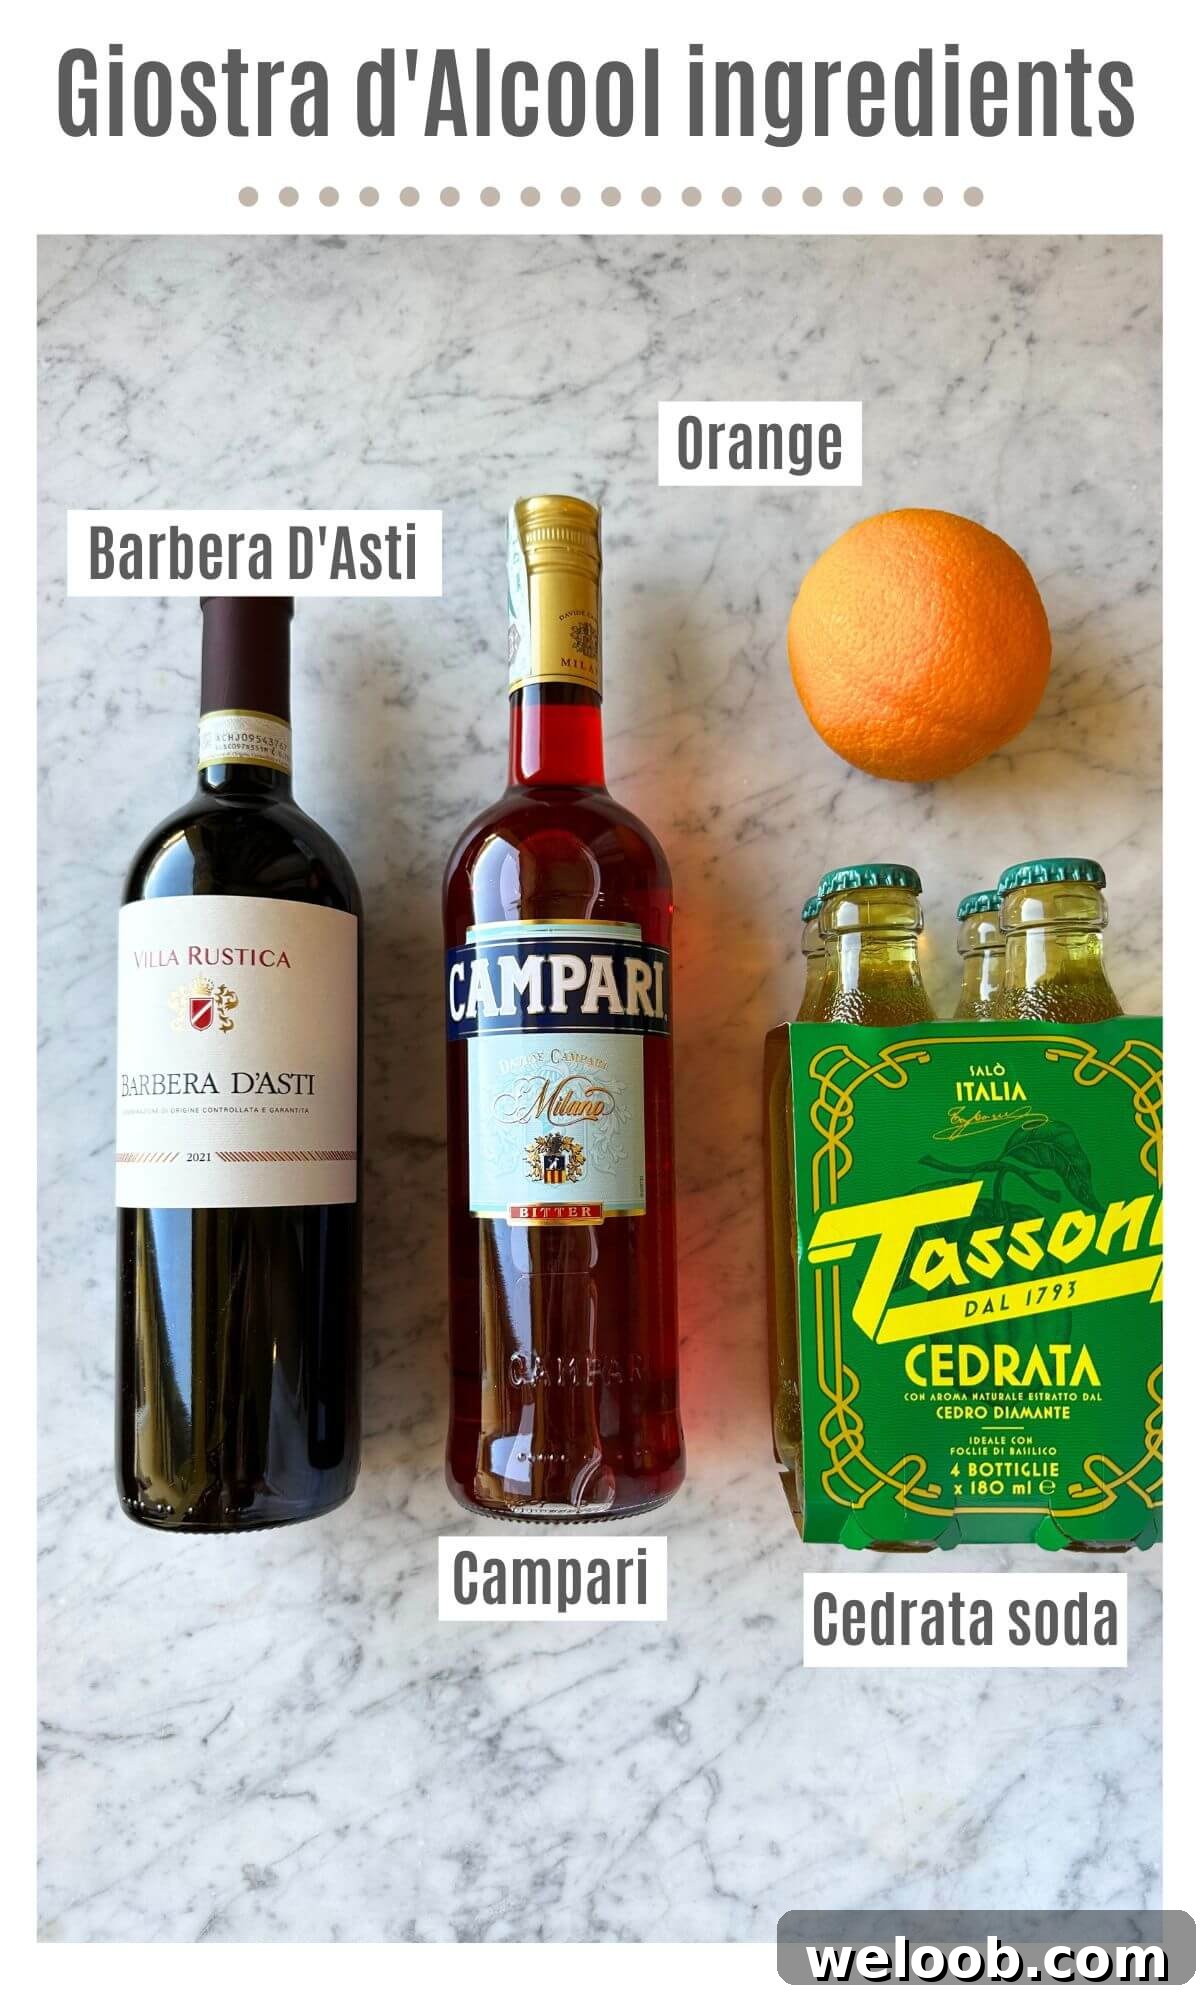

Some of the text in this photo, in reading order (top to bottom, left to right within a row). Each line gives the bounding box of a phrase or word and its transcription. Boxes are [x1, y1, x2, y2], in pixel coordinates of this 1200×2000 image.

[561, 656, 597, 673] MILA
[134, 946, 291, 969] VILLA RUSTICA
[449, 954, 665, 1022] CAMPARI
[969, 1062, 1006, 1077] SALÒ
[121, 1071, 315, 1097] BARBERA D'ASTI
[956, 1081, 1027, 1101] ITALIA
[496, 1075, 615, 1126] Milano
[202, 1106, 259, 1114] CONTROLLATA
[186, 1152, 212, 1162] 2021
[520, 1206, 591, 1218] BITTER
[965, 1281, 1077, 1318] DAL 1793
[905, 1343, 1101, 1387] CEDRATA
[904, 1392, 1102, 1402] CON AROMA NATURALE ESTRATTO DAL
[936, 1406, 1071, 1420] CEDRO DIAMANTE
[969, 1436, 1033, 1445] IDEALE CON
[950, 1447, 1057, 1456] FOGLIE DI BASILICO
[950, 1462, 1059, 1478] 4 BOTTIGLIE
[954, 1483, 963, 1495] x
[971, 1480, 1005, 1496] 180
[1012, 1480, 1032, 1495] ml
